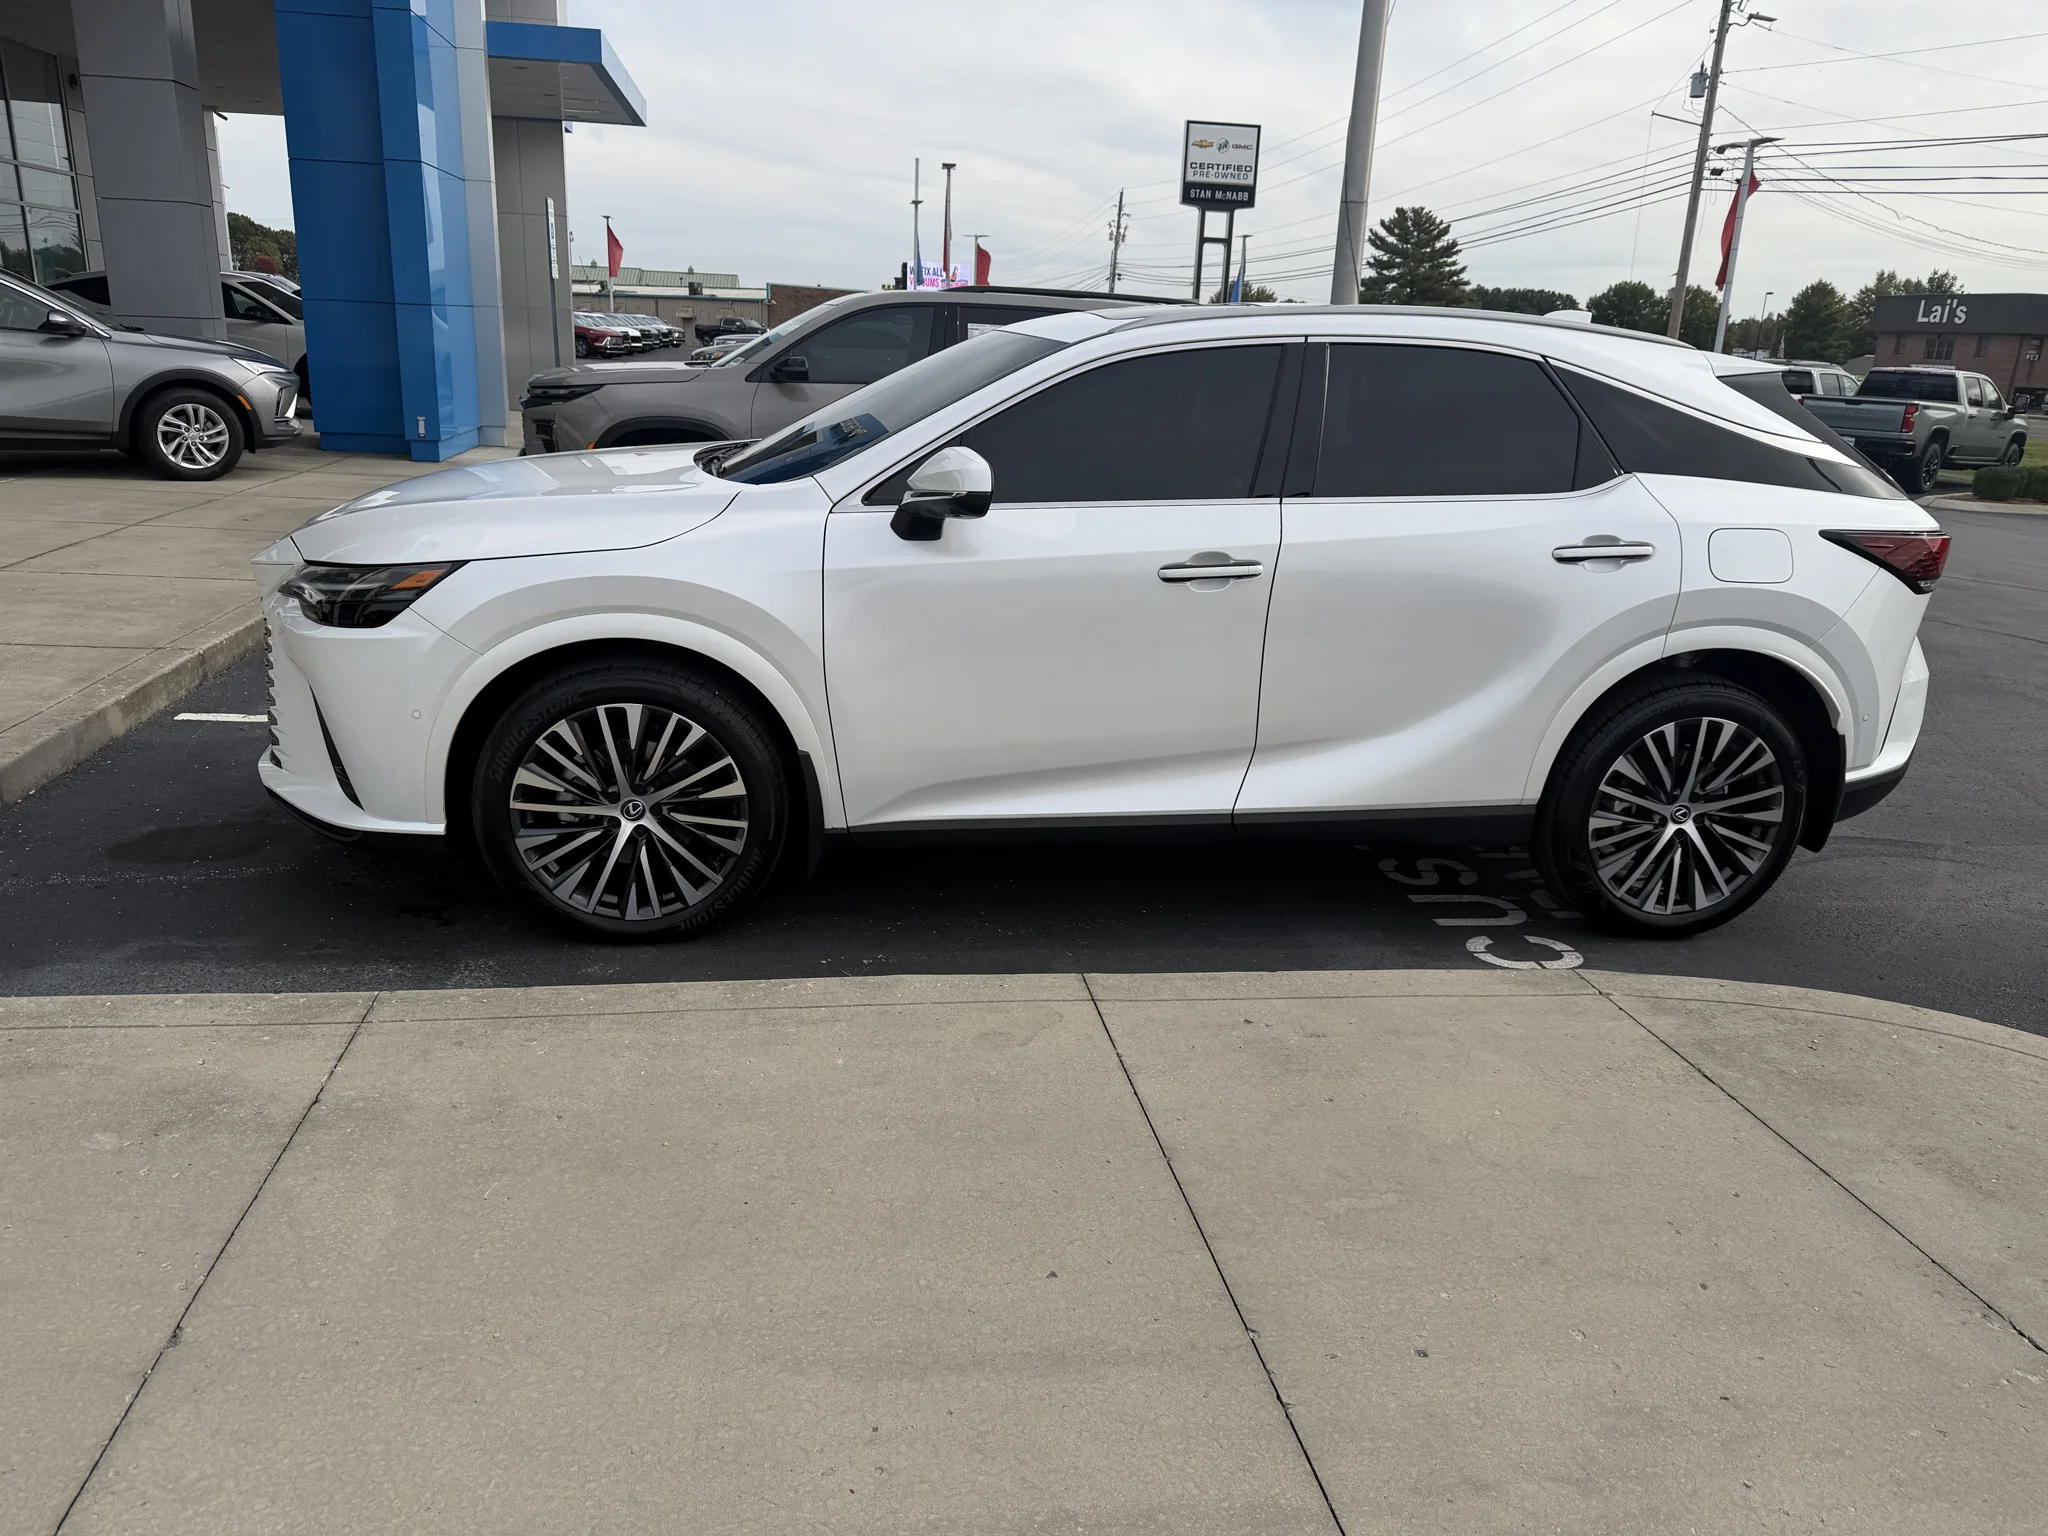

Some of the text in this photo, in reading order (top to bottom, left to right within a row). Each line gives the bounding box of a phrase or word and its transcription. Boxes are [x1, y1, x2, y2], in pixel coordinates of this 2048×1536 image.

[1189, 161, 1253, 173] CERTIFIED
[1192, 170, 1249, 180] PRE-OWNED
[1189, 188, 1249, 201] STAN McNABB
[921, 266, 931, 277] FIX
[932, 267, 944, 278] ALL
[909, 276, 940, 288] VUMS
[1916, 298, 1968, 325] Lai's
[487, 688, 583, 784] BRIDGESTONE
[675, 845, 766, 933] BRIDGESTONE
[1354, 845, 1584, 969] CUS
